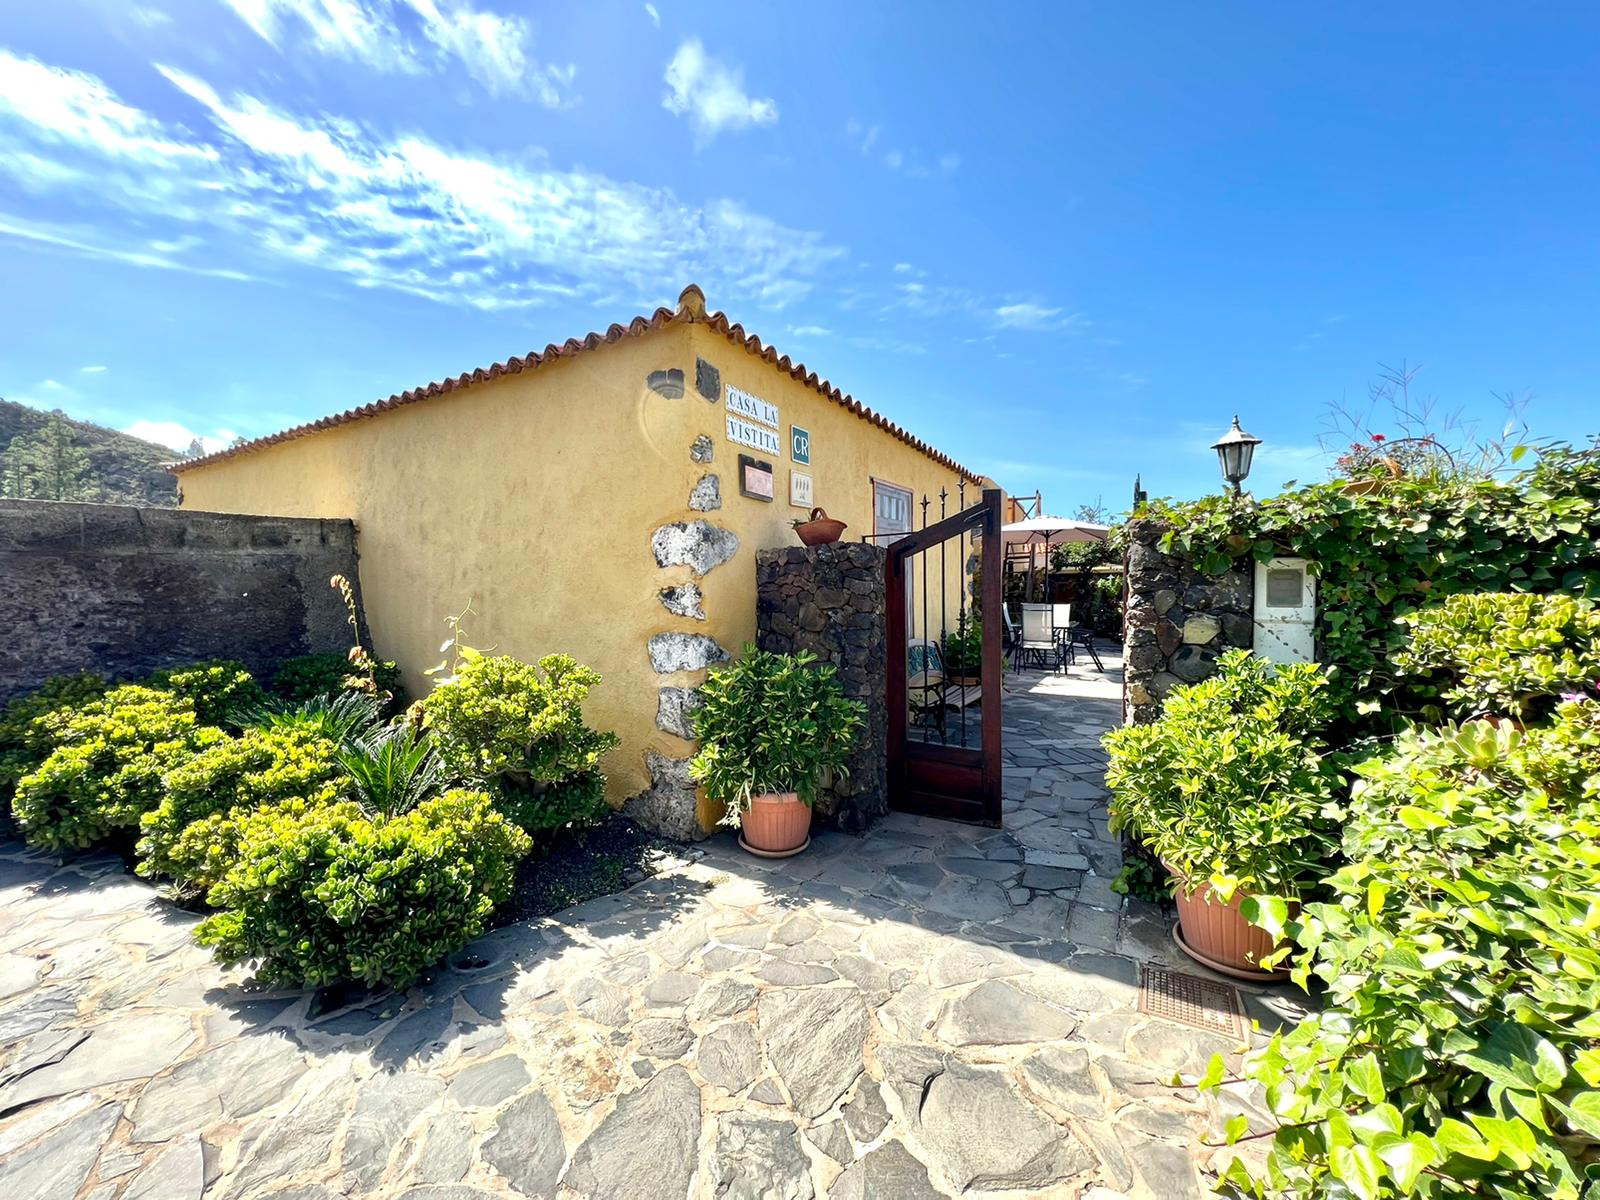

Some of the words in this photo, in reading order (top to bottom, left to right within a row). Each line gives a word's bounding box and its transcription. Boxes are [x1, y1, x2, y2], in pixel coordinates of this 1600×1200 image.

[729, 392, 758, 416] CASA
[764, 406, 777, 424] LA
[730, 421, 778, 450] VISTITA
[793, 435, 808, 456] CR
